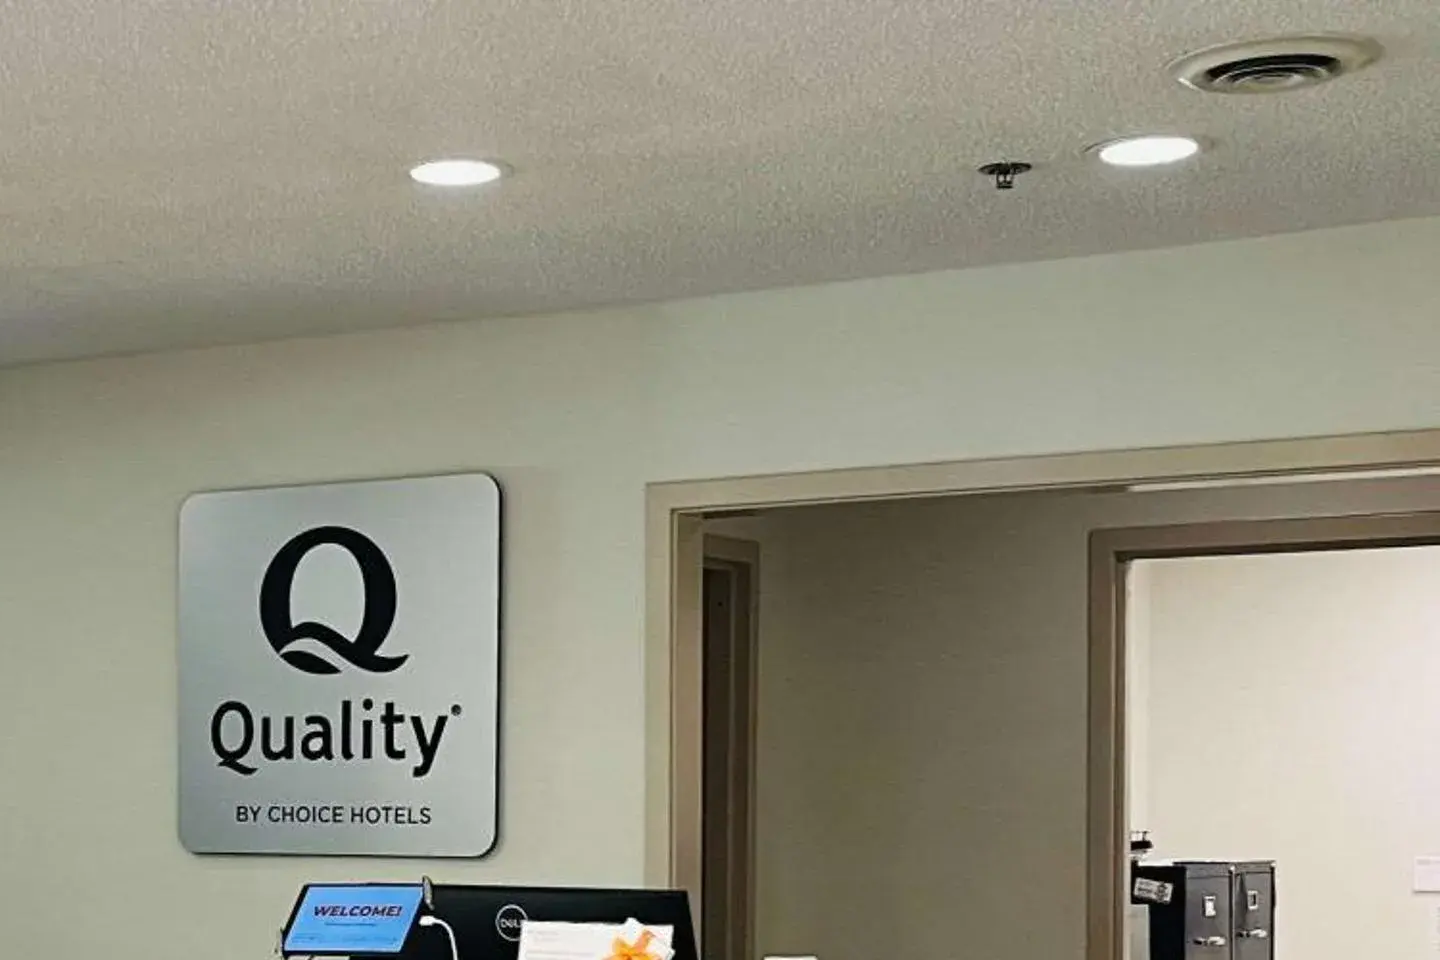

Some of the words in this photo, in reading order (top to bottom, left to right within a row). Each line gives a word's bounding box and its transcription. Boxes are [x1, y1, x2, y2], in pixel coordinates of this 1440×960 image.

[259, 525, 410, 675] Q
[210, 698, 448, 778] Quality
[235, 805, 261, 824] BY
[267, 805, 344, 824] CHOICE
[350, 806, 432, 825] HOTELS
[313, 904, 403, 917] WELCOME!
